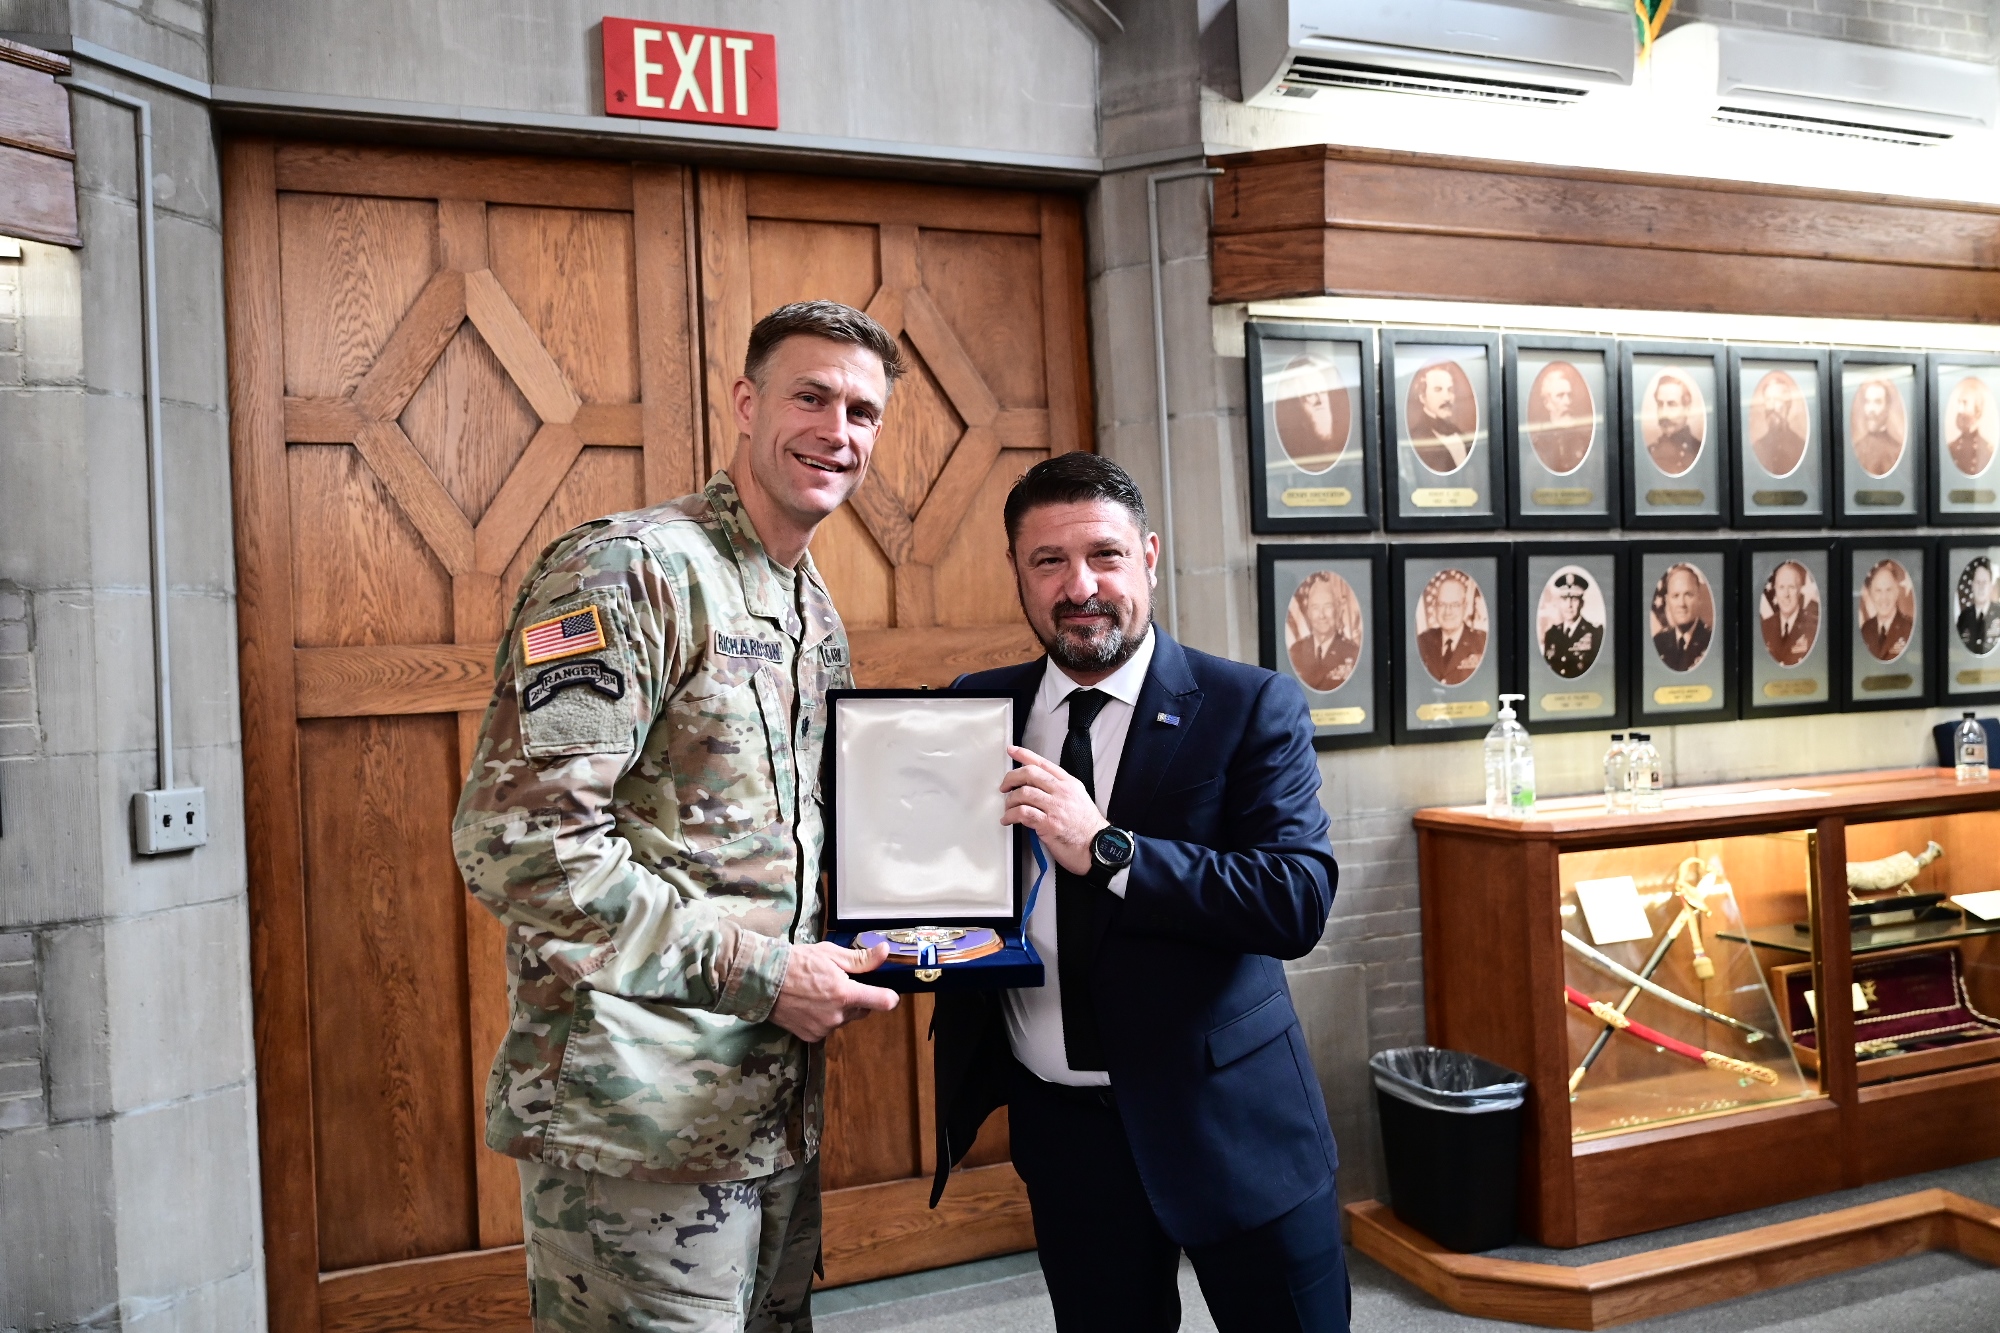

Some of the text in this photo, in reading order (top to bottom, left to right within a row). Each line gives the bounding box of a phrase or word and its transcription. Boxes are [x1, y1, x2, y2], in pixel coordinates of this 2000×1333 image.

[634, 27, 753, 116] EXIT
[543, 665, 599, 687] RANGER
[604, 674, 617, 686] BN
